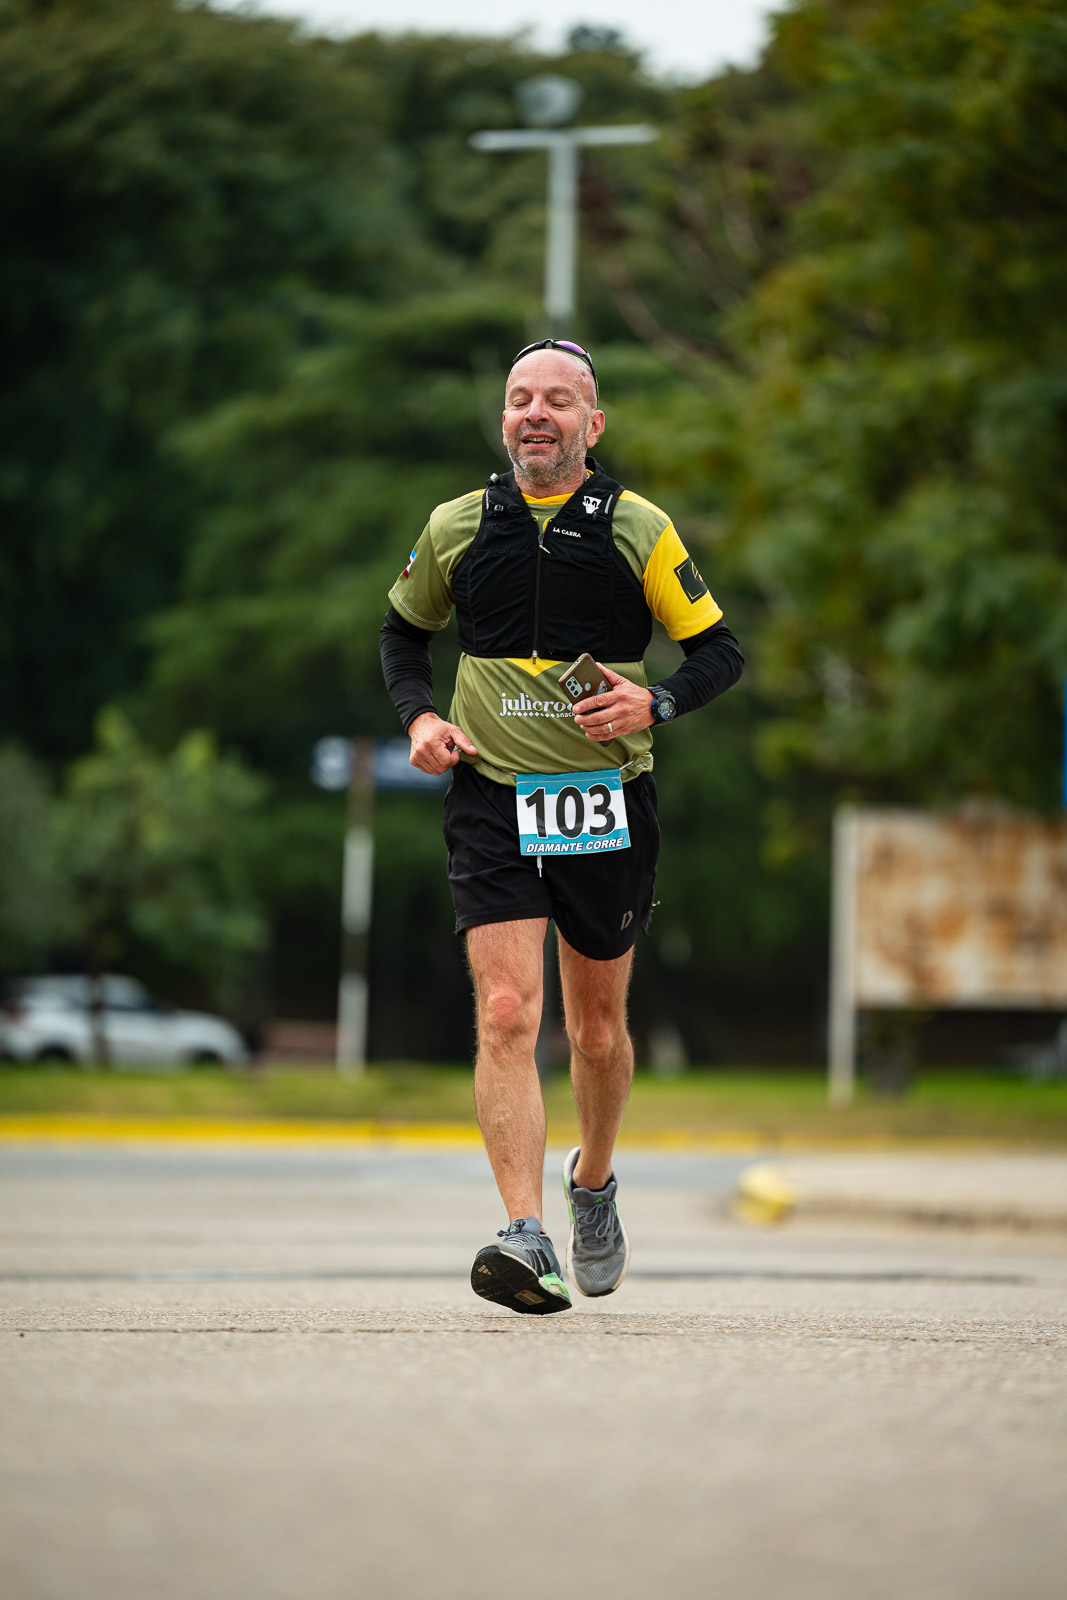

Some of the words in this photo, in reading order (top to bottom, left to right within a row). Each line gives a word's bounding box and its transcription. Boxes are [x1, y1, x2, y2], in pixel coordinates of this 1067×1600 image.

[525, 783, 616, 839] 103
[526, 842, 584, 853] DIAMANTE
[585, 838, 624, 851] CORRE
